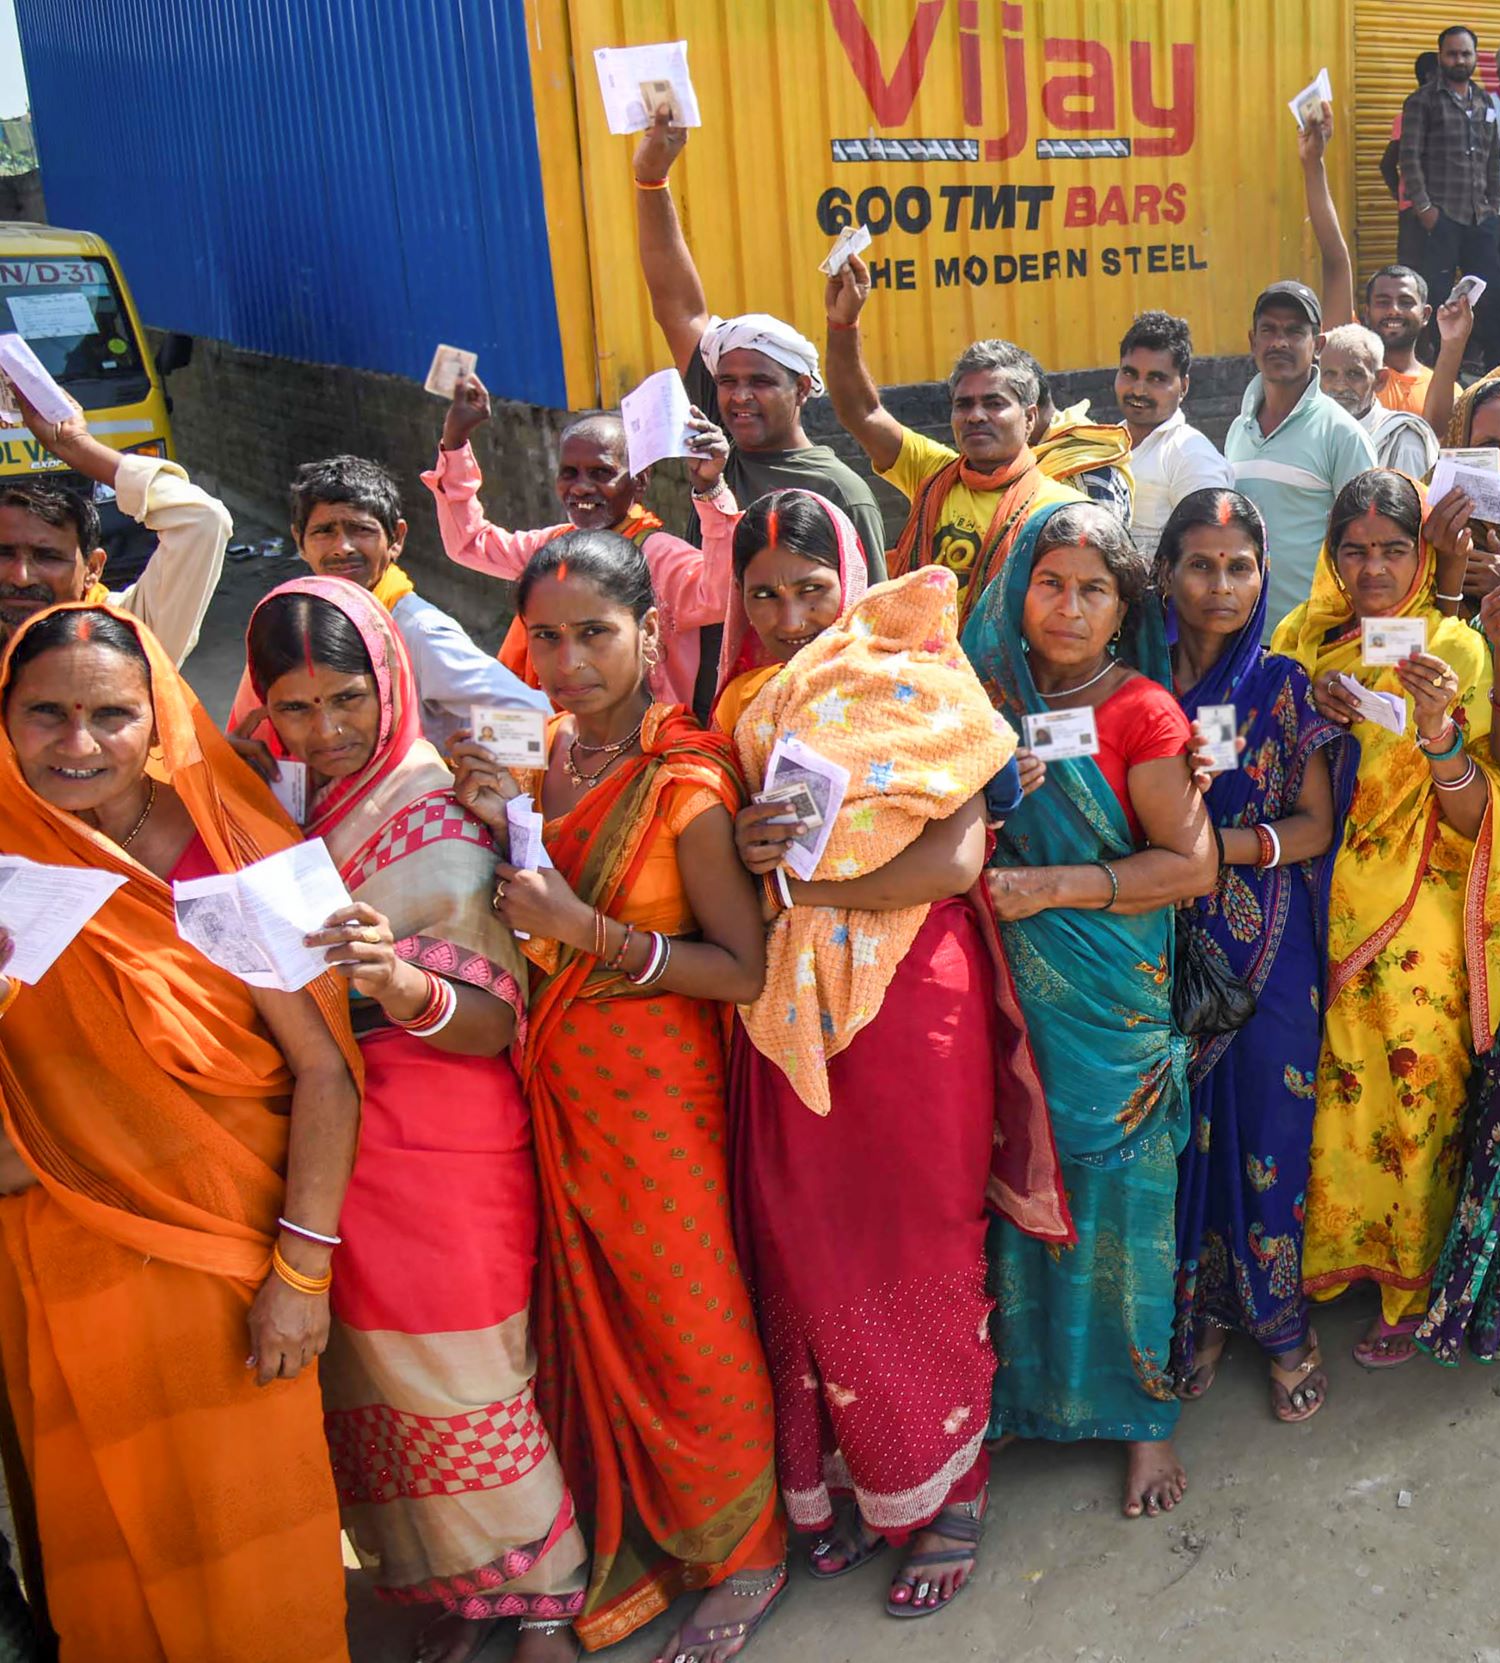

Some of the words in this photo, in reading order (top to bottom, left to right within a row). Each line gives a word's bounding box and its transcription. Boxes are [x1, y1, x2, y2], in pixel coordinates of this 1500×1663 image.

[828, 0, 1196, 163] Vijay
[816, 187, 932, 236] 600
[939, 184, 1055, 232] TMT
[1063, 183, 1187, 228] BARS
[869, 257, 916, 290] HE
[1102, 244, 1208, 277] STEEL
